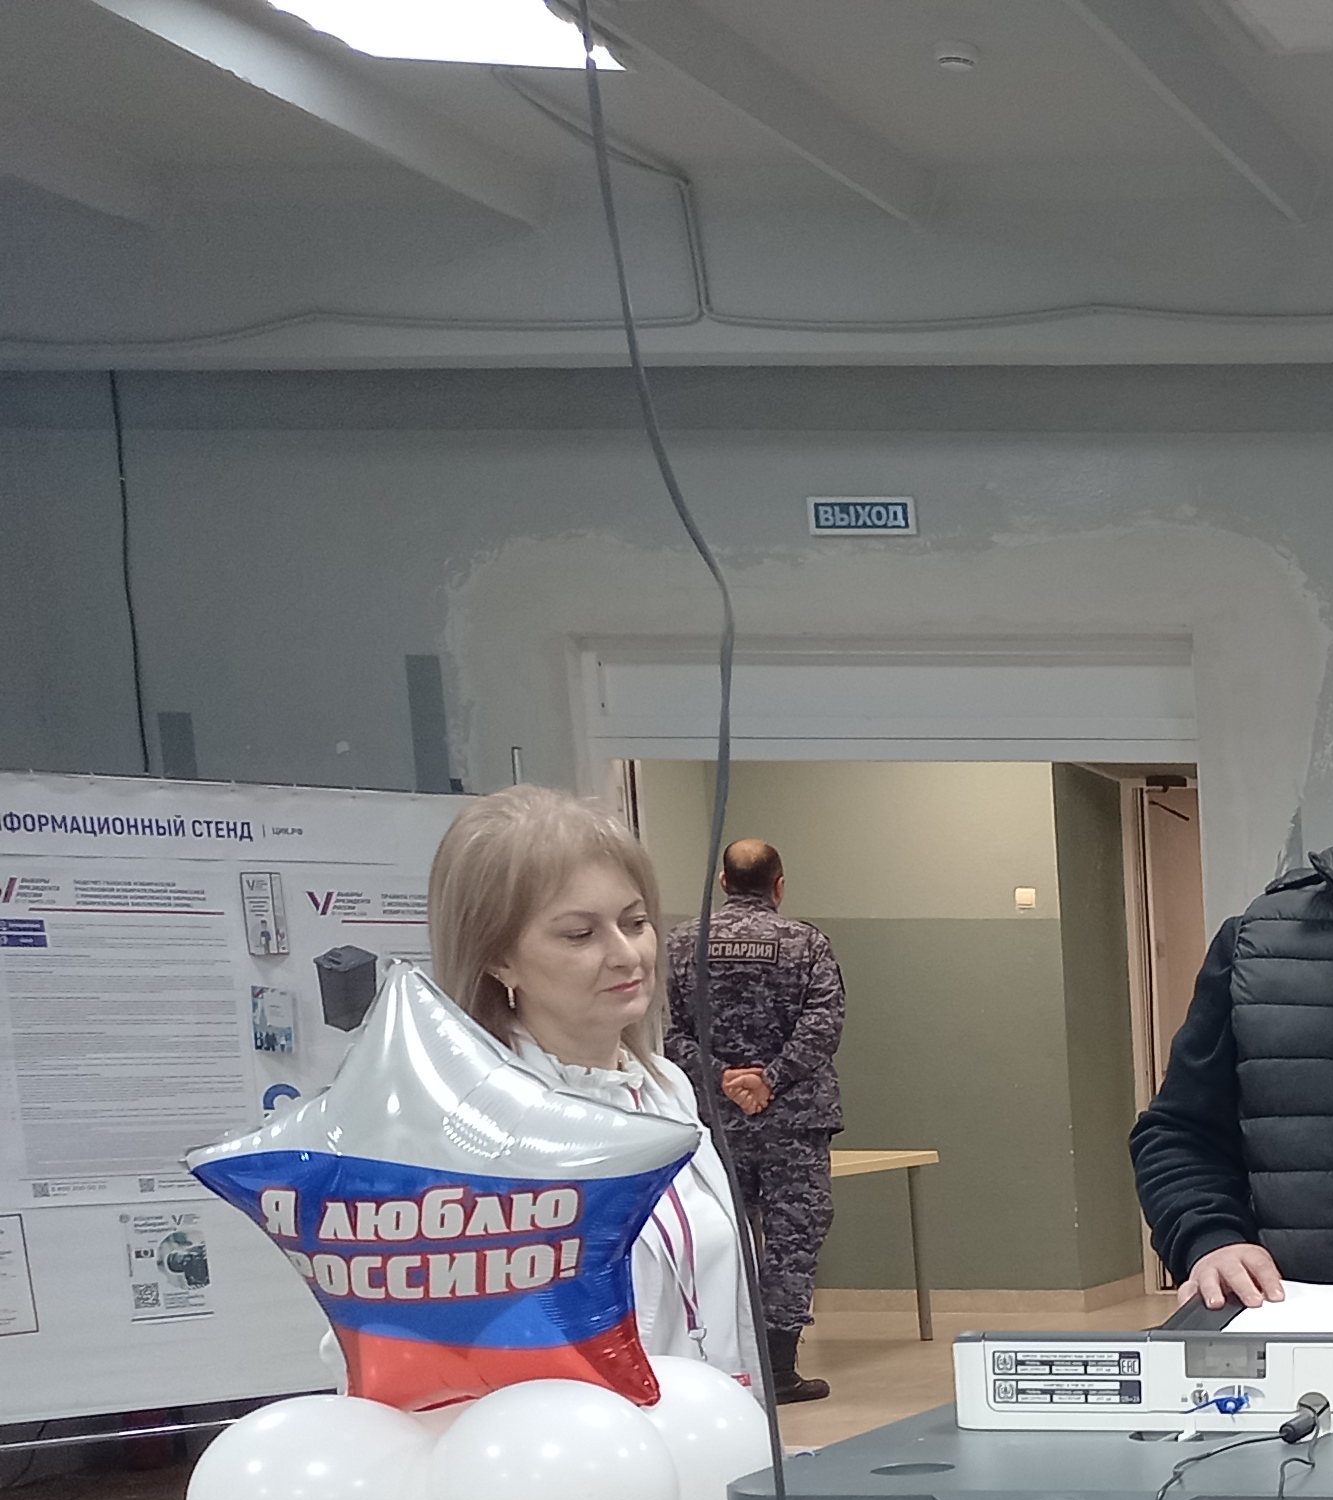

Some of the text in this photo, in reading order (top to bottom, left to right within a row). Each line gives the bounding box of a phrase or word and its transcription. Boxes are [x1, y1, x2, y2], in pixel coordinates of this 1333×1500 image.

[818, 505, 906, 527] ВЫХОД
[0, 812, 187, 837] ФОРМАЦИОННЫЙ
[191, 819, 254, 842] СТЕНД
[708, 943, 774, 958] СГВАРДИЯ
[261, 1189, 299, 1238] Я
